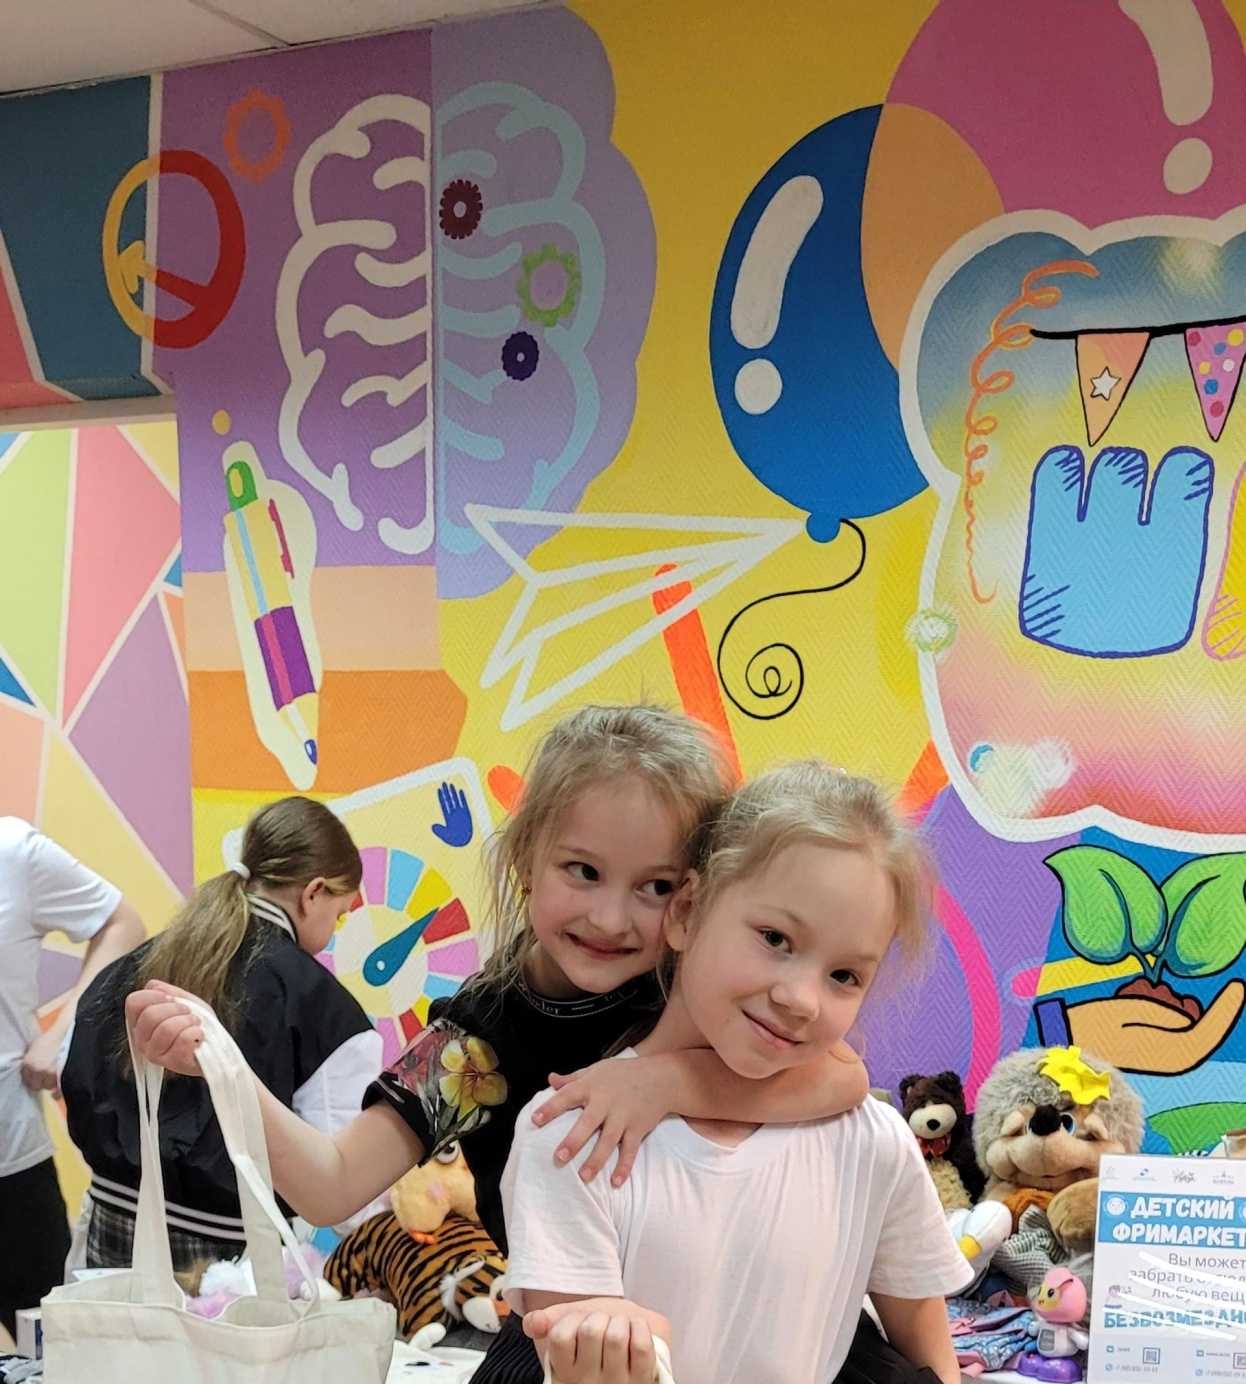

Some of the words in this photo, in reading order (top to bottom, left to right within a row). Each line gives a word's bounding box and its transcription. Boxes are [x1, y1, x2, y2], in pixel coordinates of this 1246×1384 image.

[1019, 444, 1246, 661] Ш
[1130, 1195, 1235, 1220] ДЕТСКИЙ
[1112, 1222, 1246, 1248] ФРИМАРКЕТ
[1168, 1252, 1191, 1266] Вы
